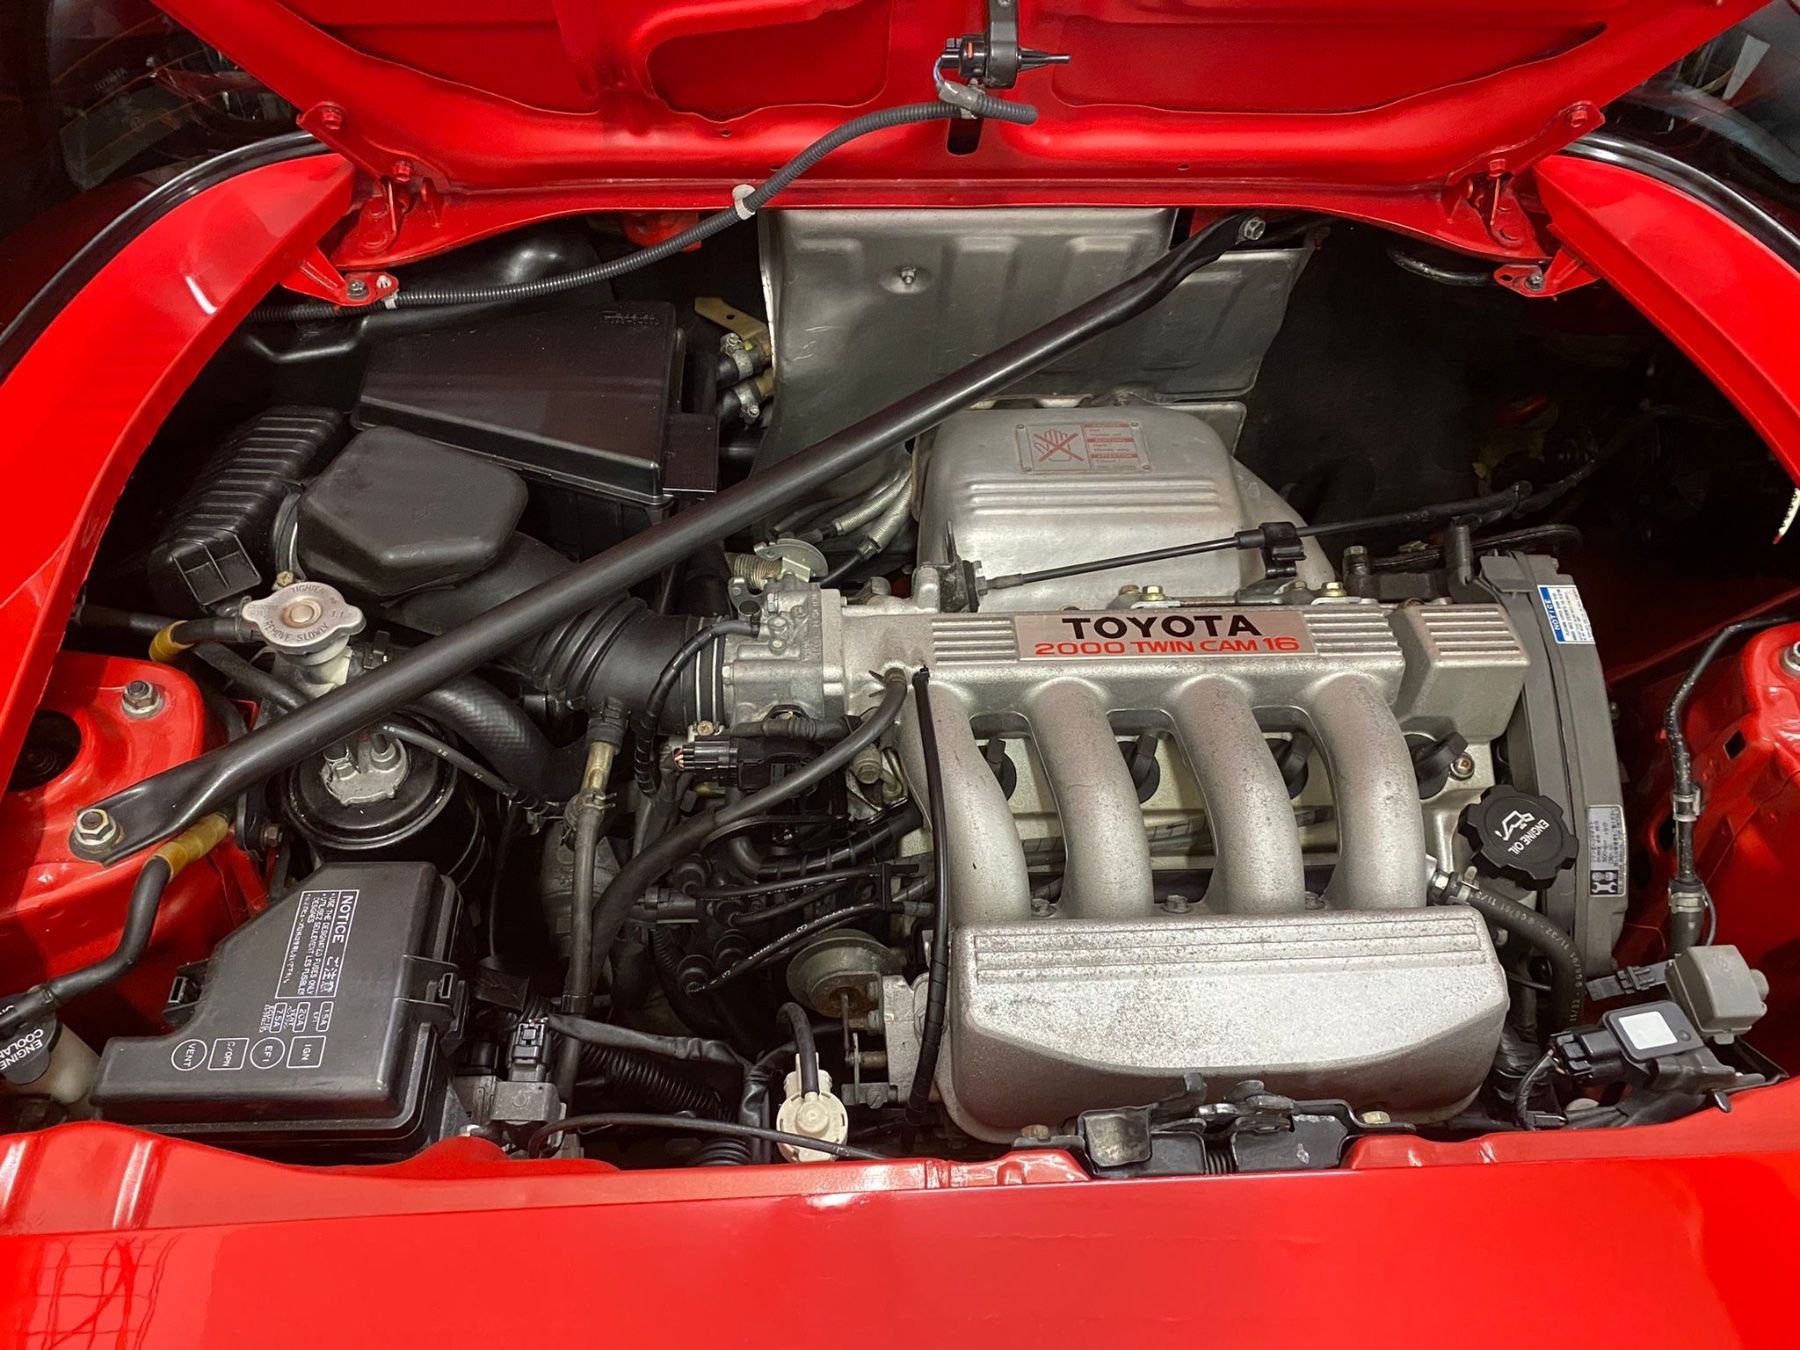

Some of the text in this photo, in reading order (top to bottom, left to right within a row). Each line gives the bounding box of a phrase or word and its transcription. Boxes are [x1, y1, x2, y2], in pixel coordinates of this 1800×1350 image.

[1545, 599, 1561, 630] NOTICE
[264, 620, 329, 641] REMOVE SLOWLY
[1062, 615, 1262, 639] TOYOTA
[1035, 636, 1299, 655] 2000 TWIN CAM 16
[1508, 819, 1550, 854] ENGINE OIL
[331, 895, 353, 943] NOTICE
[309, 958, 321, 977] FUSES
[297, 1008, 307, 1026] 20A
[320, 1009, 330, 1026] 15A
[0, 1039, 43, 1071] ENGINE
[183, 1043, 197, 1067] VENT
[222, 1041, 235, 1067] C/OPN
[262, 1045, 273, 1062] EFI
[301, 1043, 312, 1061] IGN
